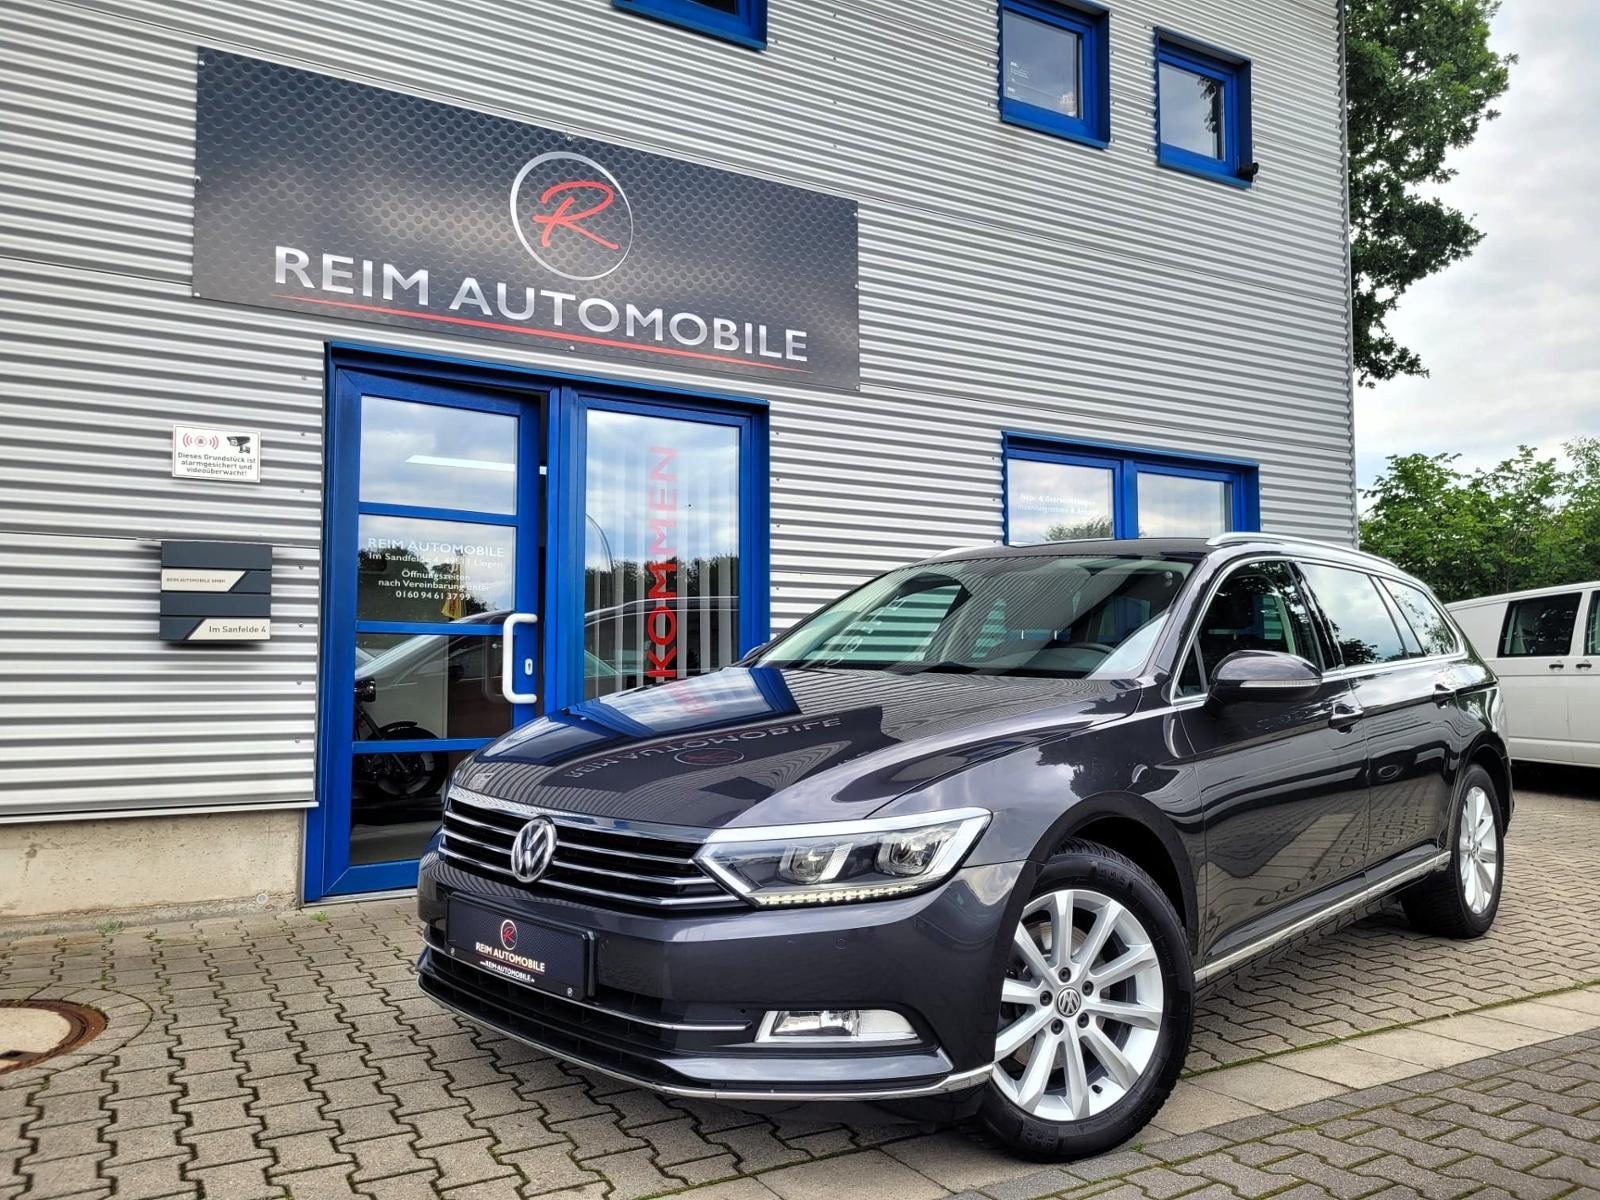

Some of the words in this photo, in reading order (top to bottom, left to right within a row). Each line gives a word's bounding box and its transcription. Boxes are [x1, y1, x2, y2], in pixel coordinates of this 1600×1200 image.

[532, 180, 620, 248] R
[275, 245, 429, 306] REIM
[448, 276, 808, 362] AUTOMOBILE
[177, 451, 202, 460] Dieses
[203, 453, 245, 463] Grundstück
[181, 459, 238, 470] alarmgesichert
[186, 466, 248, 476] videoüberwacht!
[367, 537, 406, 551] REIM
[408, 541, 505, 558] AUTOMOBILE
[369, 552, 382, 560] Im
[646, 446, 678, 679] KOMMEN
[401, 567, 471, 581] Öffnungszeiten
[378, 579, 401, 588] nach
[402, 580, 465, 593] Vereinbarung
[395, 590, 419, 599] 0160
[420, 591, 432, 599] 94
[433, 591, 444, 600] 61
[222, 625, 259, 634] Sanfelde
[475, 941, 493, 956] REIM
[492, 948, 546, 973] AUTOMOBILE
